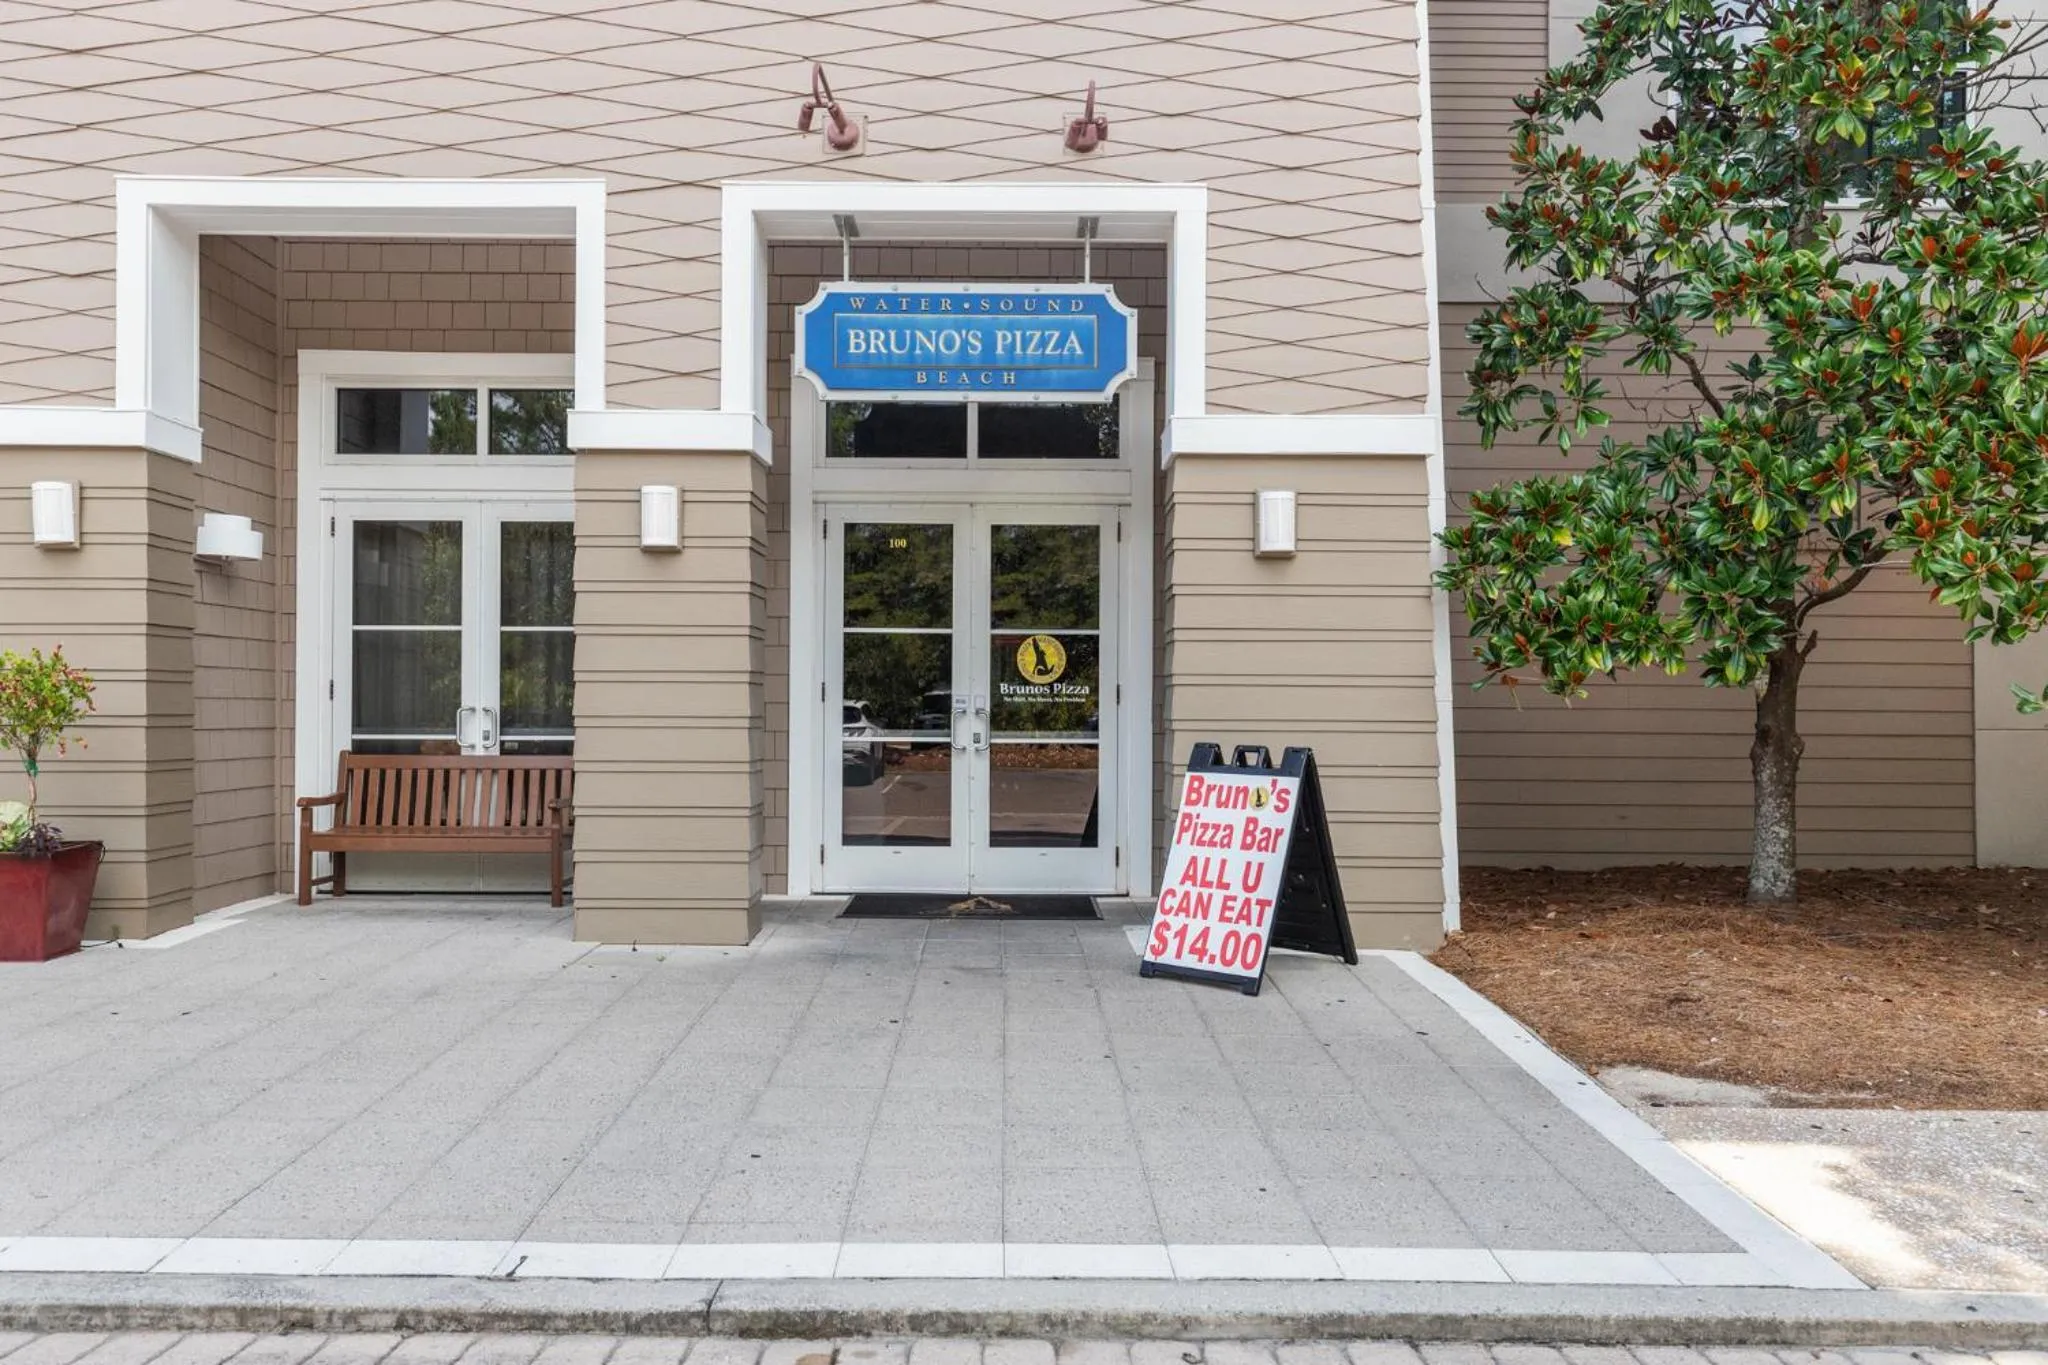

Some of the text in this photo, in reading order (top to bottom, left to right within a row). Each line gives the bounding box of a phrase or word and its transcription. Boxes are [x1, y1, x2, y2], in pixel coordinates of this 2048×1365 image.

[850, 297, 1084, 313] WATER SOUND
[847, 328, 1084, 355] BRUNO'S PIZZA
[916, 371, 1016, 385] BEACH
[889, 538, 907, 549] 100
[1000, 682, 1090, 695] Brunos Pizza
[1176, 812, 1285, 853] Pizza Bar
[1179, 855, 1264, 894] ALL U
[1159, 887, 1273, 927] CAN EAT
[1149, 918, 1263, 971] $14.00
